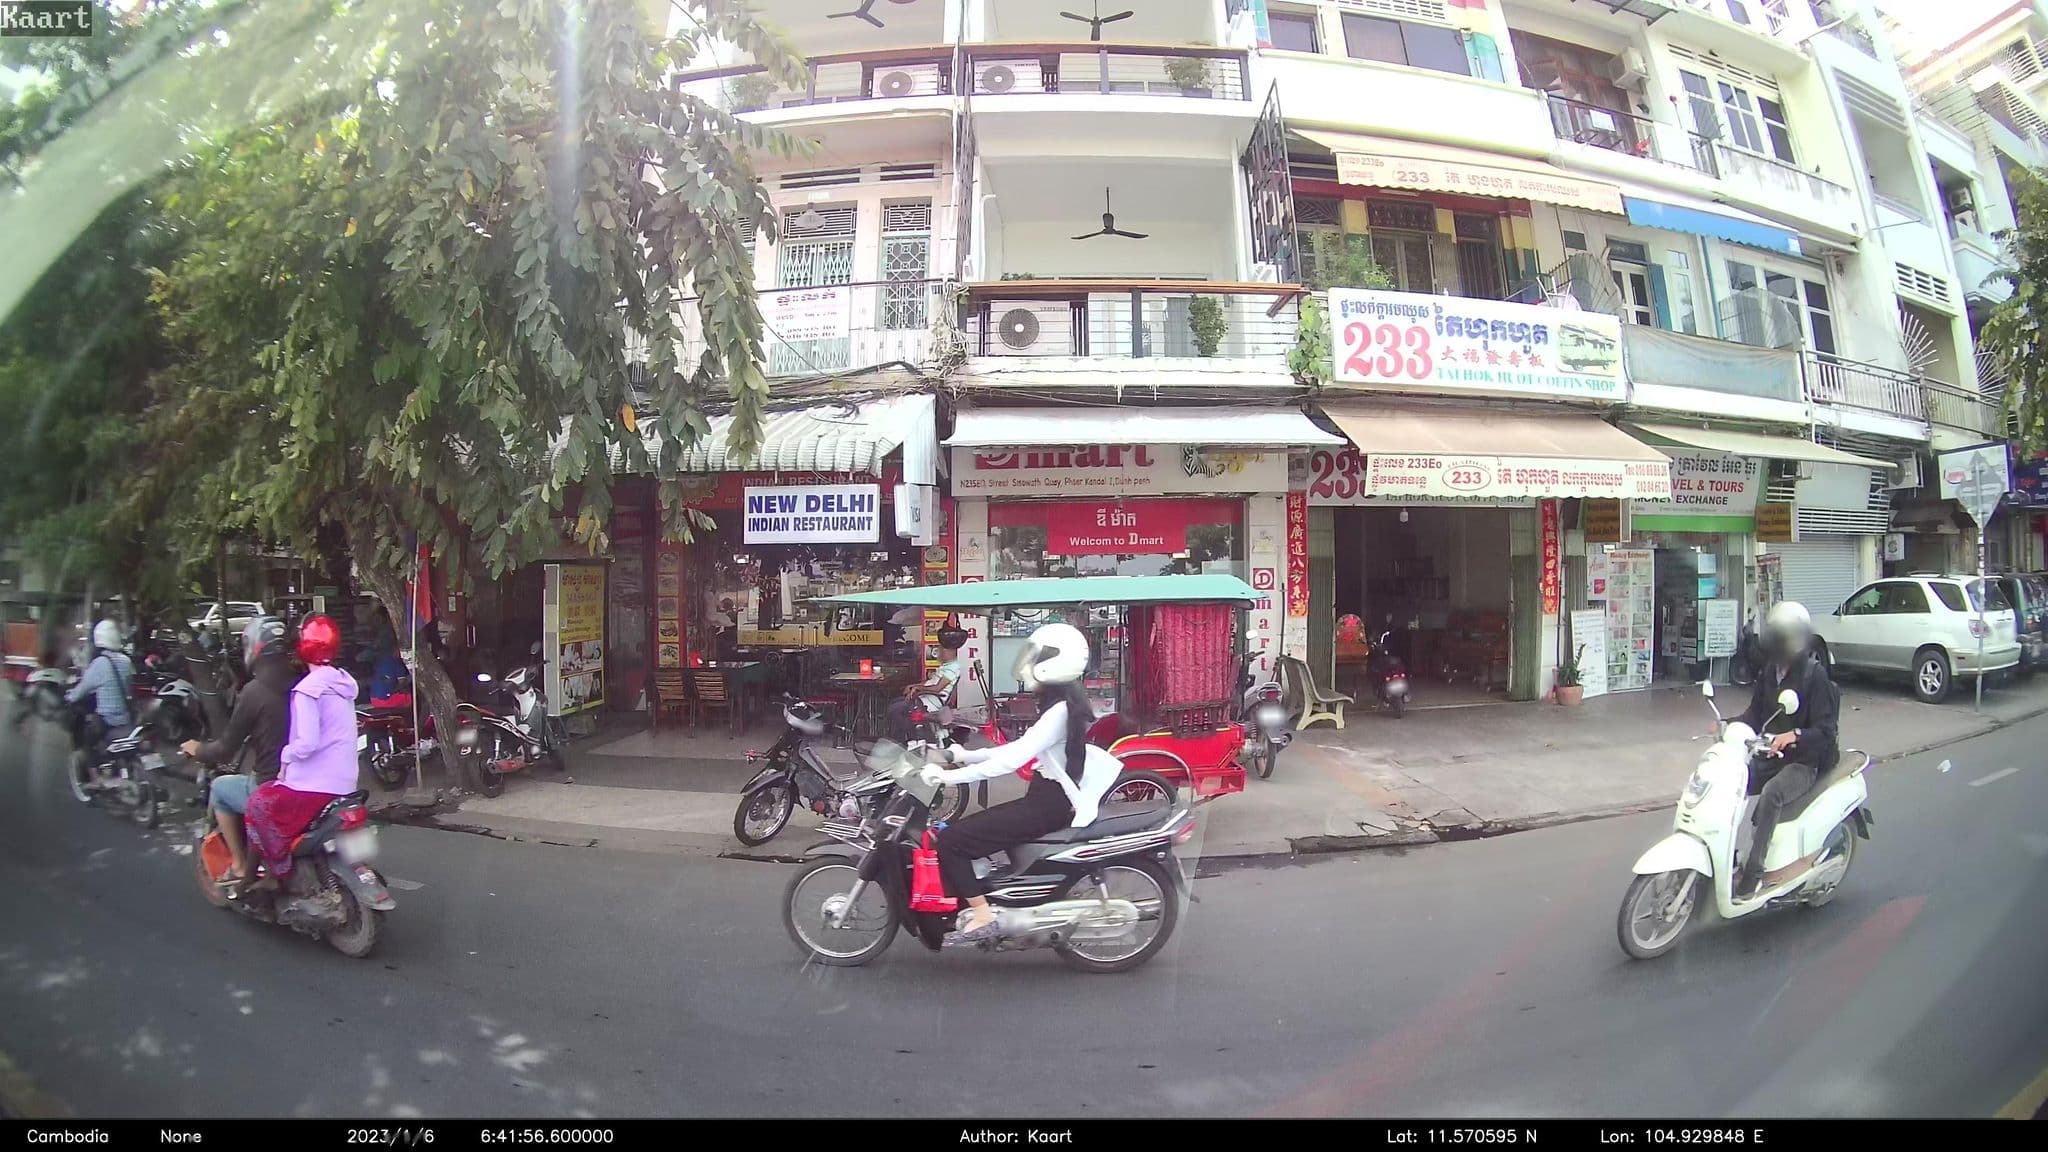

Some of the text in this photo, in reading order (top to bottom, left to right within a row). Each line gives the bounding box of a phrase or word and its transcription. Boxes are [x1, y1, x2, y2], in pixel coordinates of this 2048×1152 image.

[1397, 170, 1430, 183] 233
[1343, 322, 1433, 380] 233
[1436, 367, 1460, 380] TAI
[1463, 369, 1494, 382] HOK
[1585, 379, 1616, 393] SHOP
[1310, 451, 1368, 499] 23
[1452, 471, 1482, 484] 233
[1698, 480, 1705, 491] &
[1709, 480, 1744, 492] TOURS
[748, 495, 798, 513] NEW
[805, 494, 874, 513] DELHI
[1676, 494, 1728, 505] EXCHANGE
[748, 516, 873, 532] INDIAN RESTAURANT
[1069, 536, 1111, 546] Welcom
[1114, 537, 1125, 546] to
